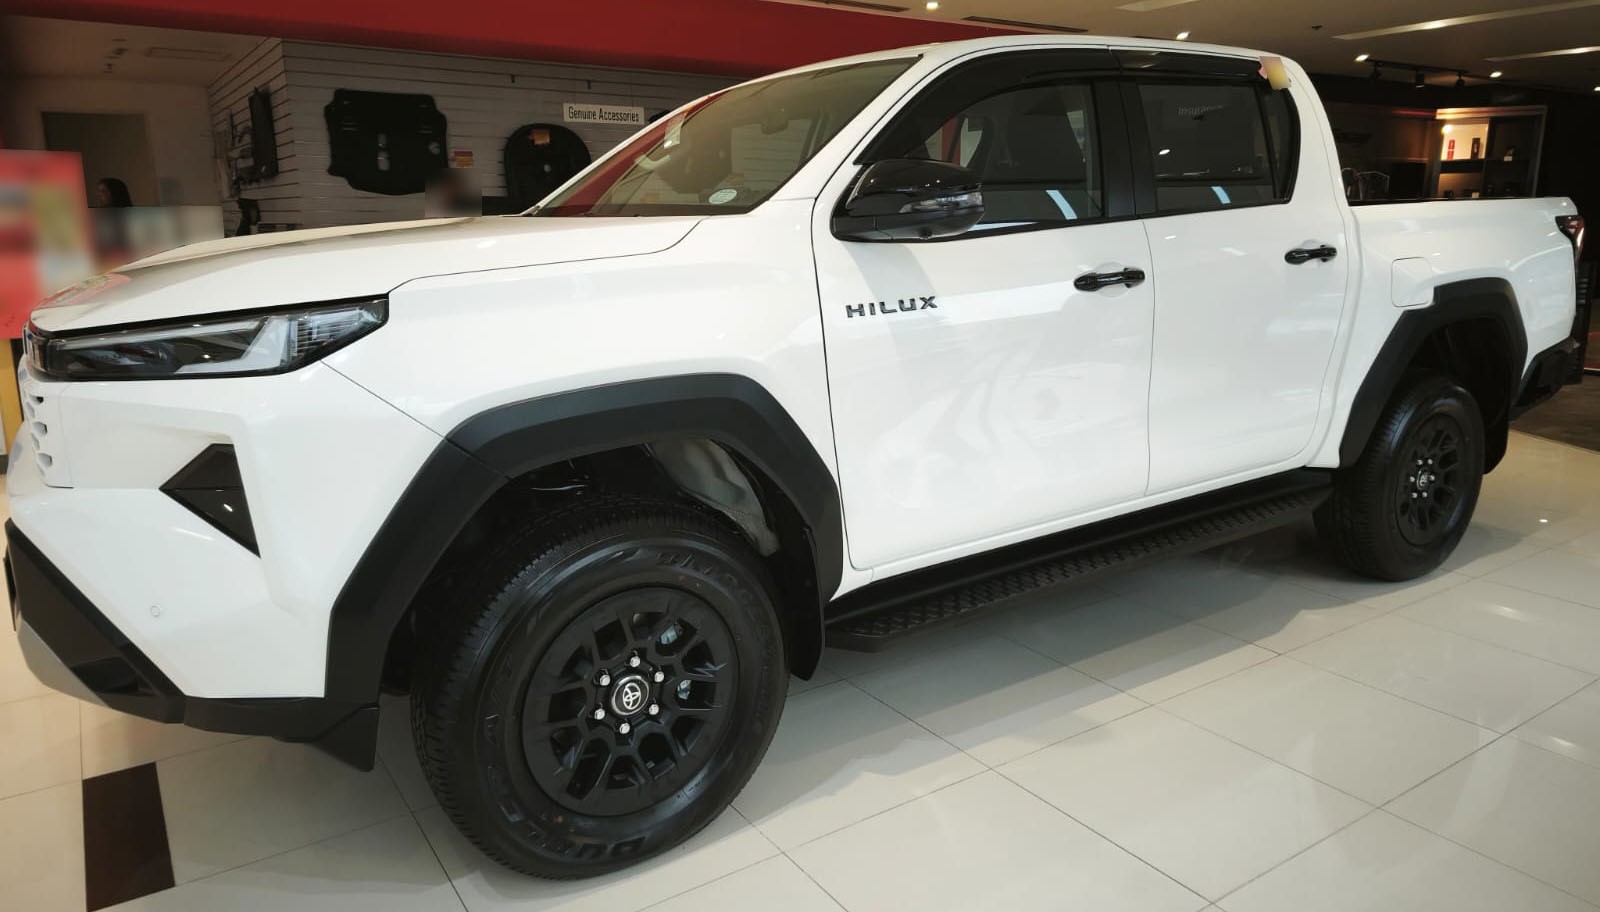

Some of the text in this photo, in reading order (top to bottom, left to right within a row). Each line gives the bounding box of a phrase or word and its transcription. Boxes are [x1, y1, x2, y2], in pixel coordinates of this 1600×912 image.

[568, 106, 640, 122] Genuine Accessories
[845, 296, 938, 318] HILUX
